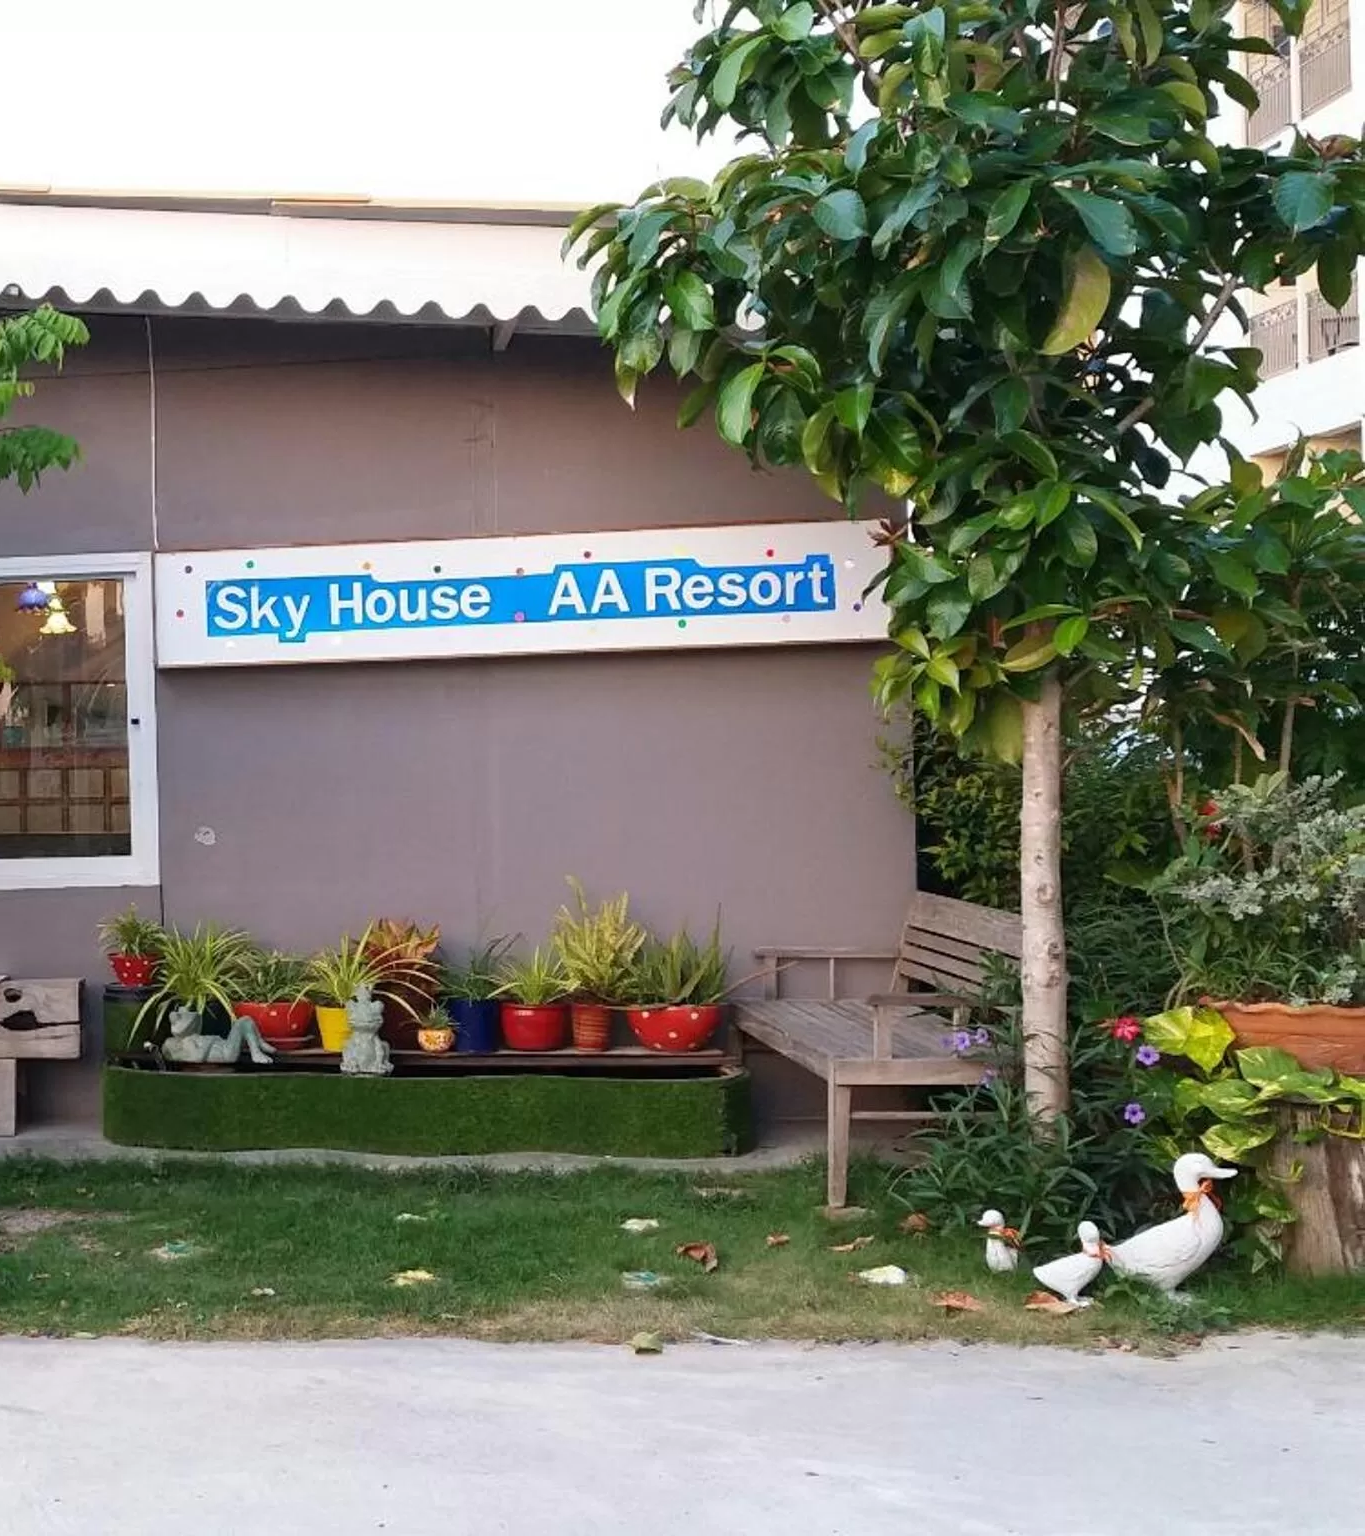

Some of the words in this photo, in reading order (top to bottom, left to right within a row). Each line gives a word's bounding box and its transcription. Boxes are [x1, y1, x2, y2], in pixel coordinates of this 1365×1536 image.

[214, 585, 311, 638] Sky
[329, 582, 491, 625] House
[548, 569, 630, 614] AA
[644, 565, 829, 611] Resort
